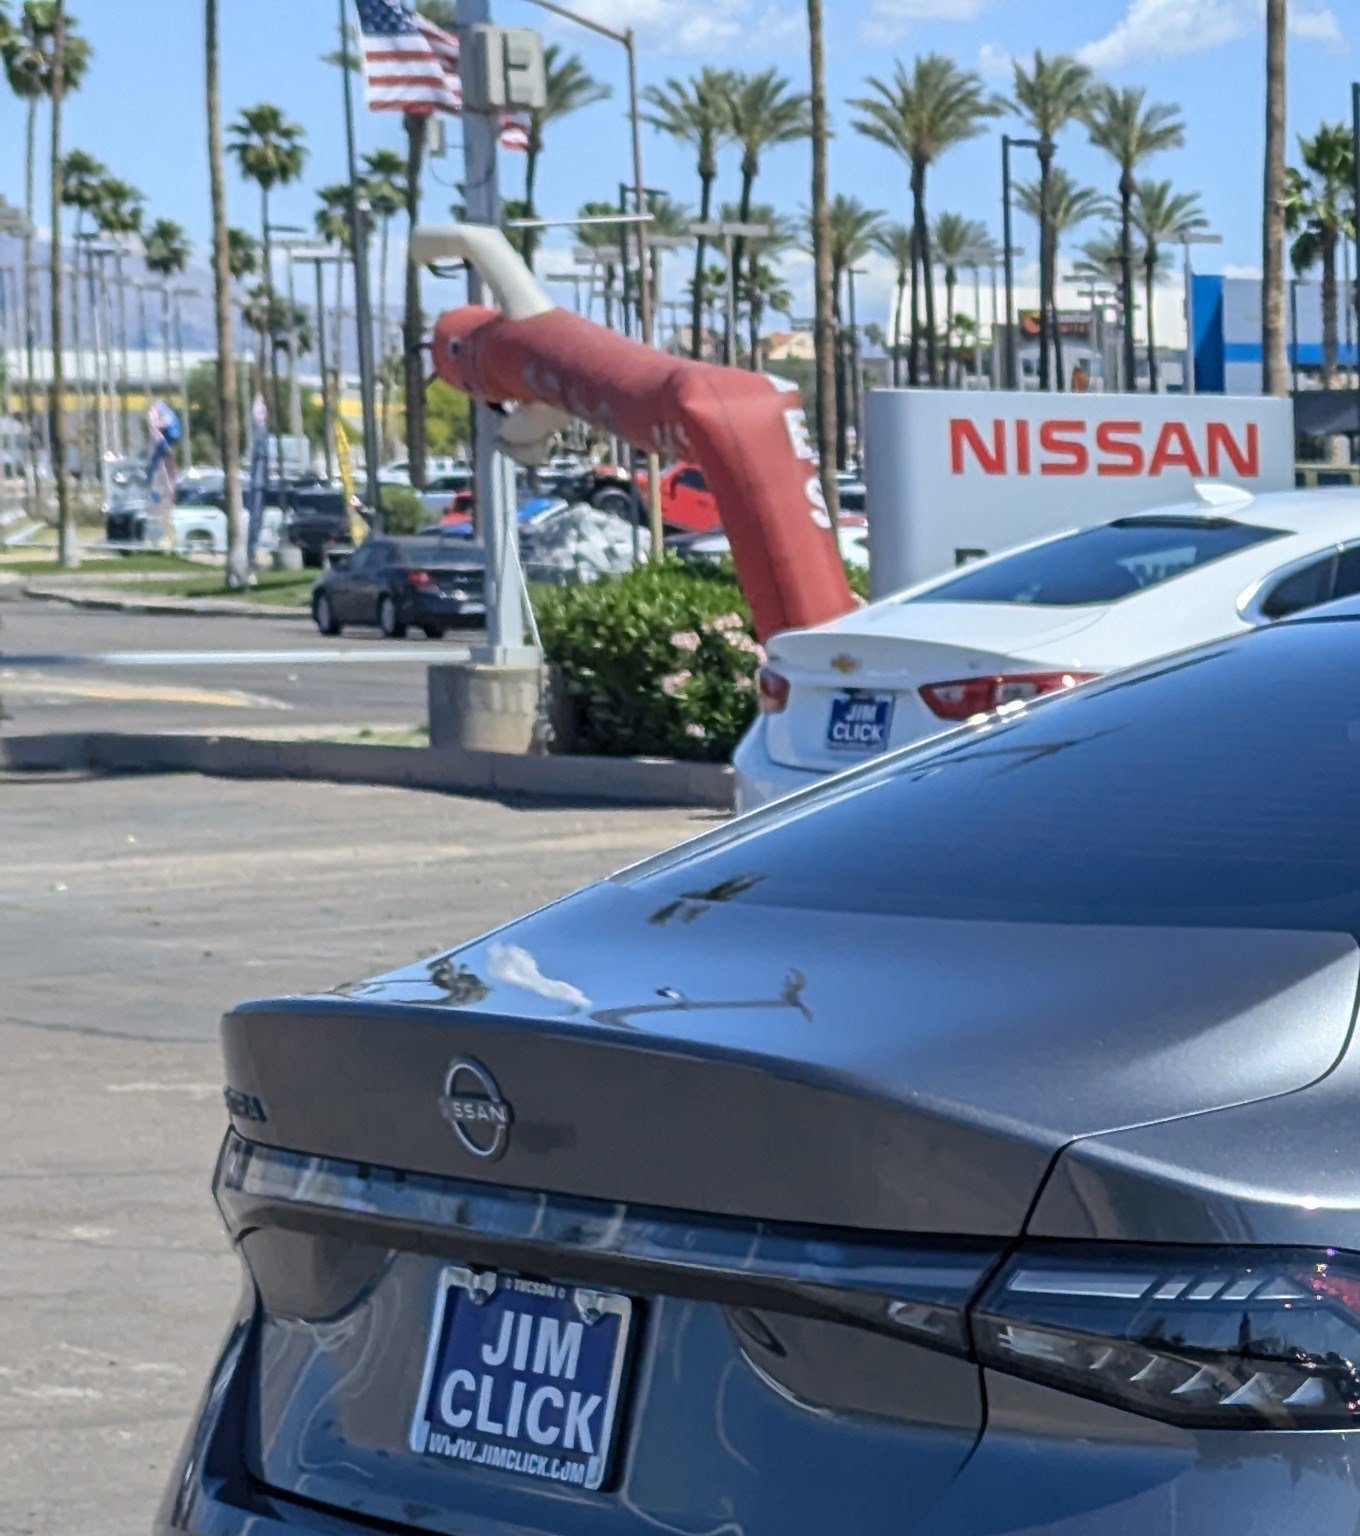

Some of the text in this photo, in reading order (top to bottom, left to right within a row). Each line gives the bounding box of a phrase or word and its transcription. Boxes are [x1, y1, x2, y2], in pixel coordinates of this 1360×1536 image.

[950, 418, 1259, 478] NISSAN
[833, 722, 884, 741] CLICK
[845, 704, 877, 721] JIM
[482, 1310, 584, 1380] JIM
[440, 1368, 603, 1454] CLICK
